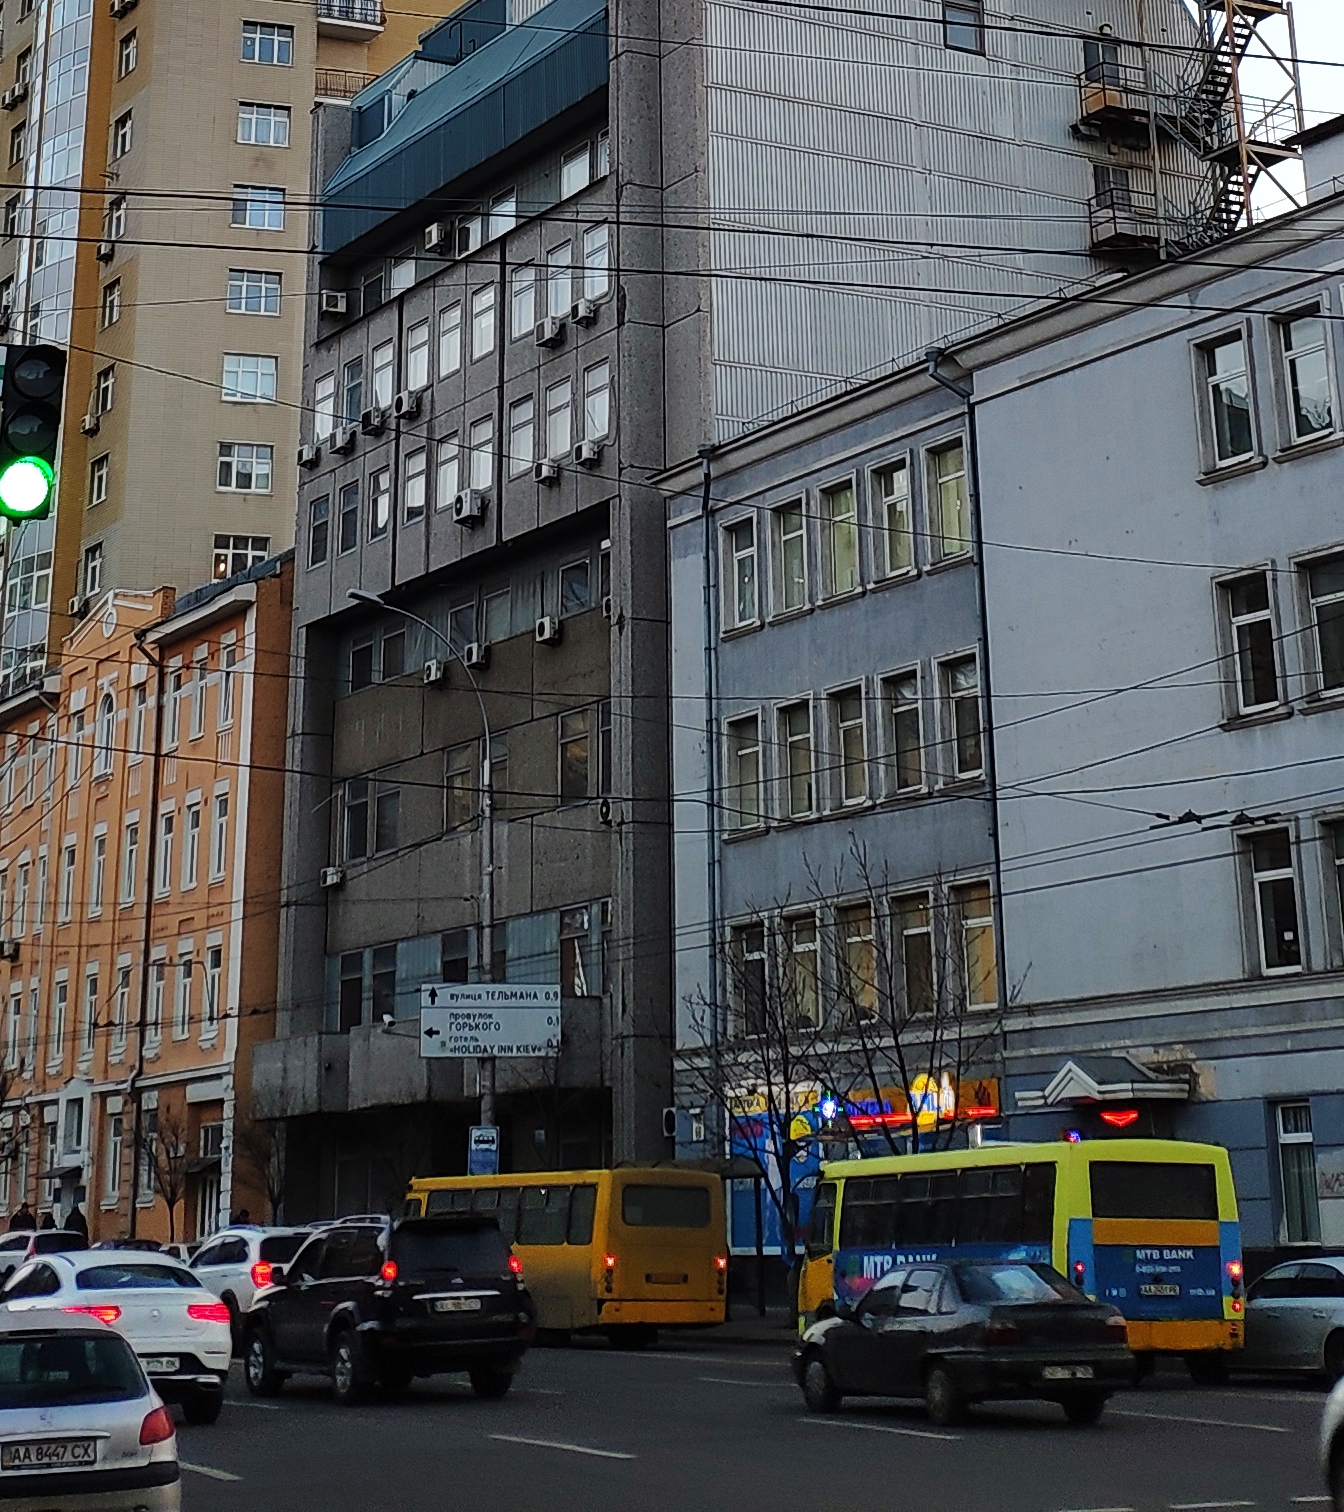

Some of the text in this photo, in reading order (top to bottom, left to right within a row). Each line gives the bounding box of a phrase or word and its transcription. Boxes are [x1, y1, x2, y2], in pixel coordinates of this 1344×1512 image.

[449, 992, 483, 1003] вулиця
[485, 990, 539, 1001] ТЕЛЬМАНА
[449, 1012, 494, 1022] провулок
[448, 1022, 501, 1032] ГОРЬКОГО
[448, 1035, 479, 1043] готель
[497, 1044, 514, 1054] INN
[1162, 1248, 1195, 1260] BANK
[12, 1441, 93, 1462] AA 8447 CX
